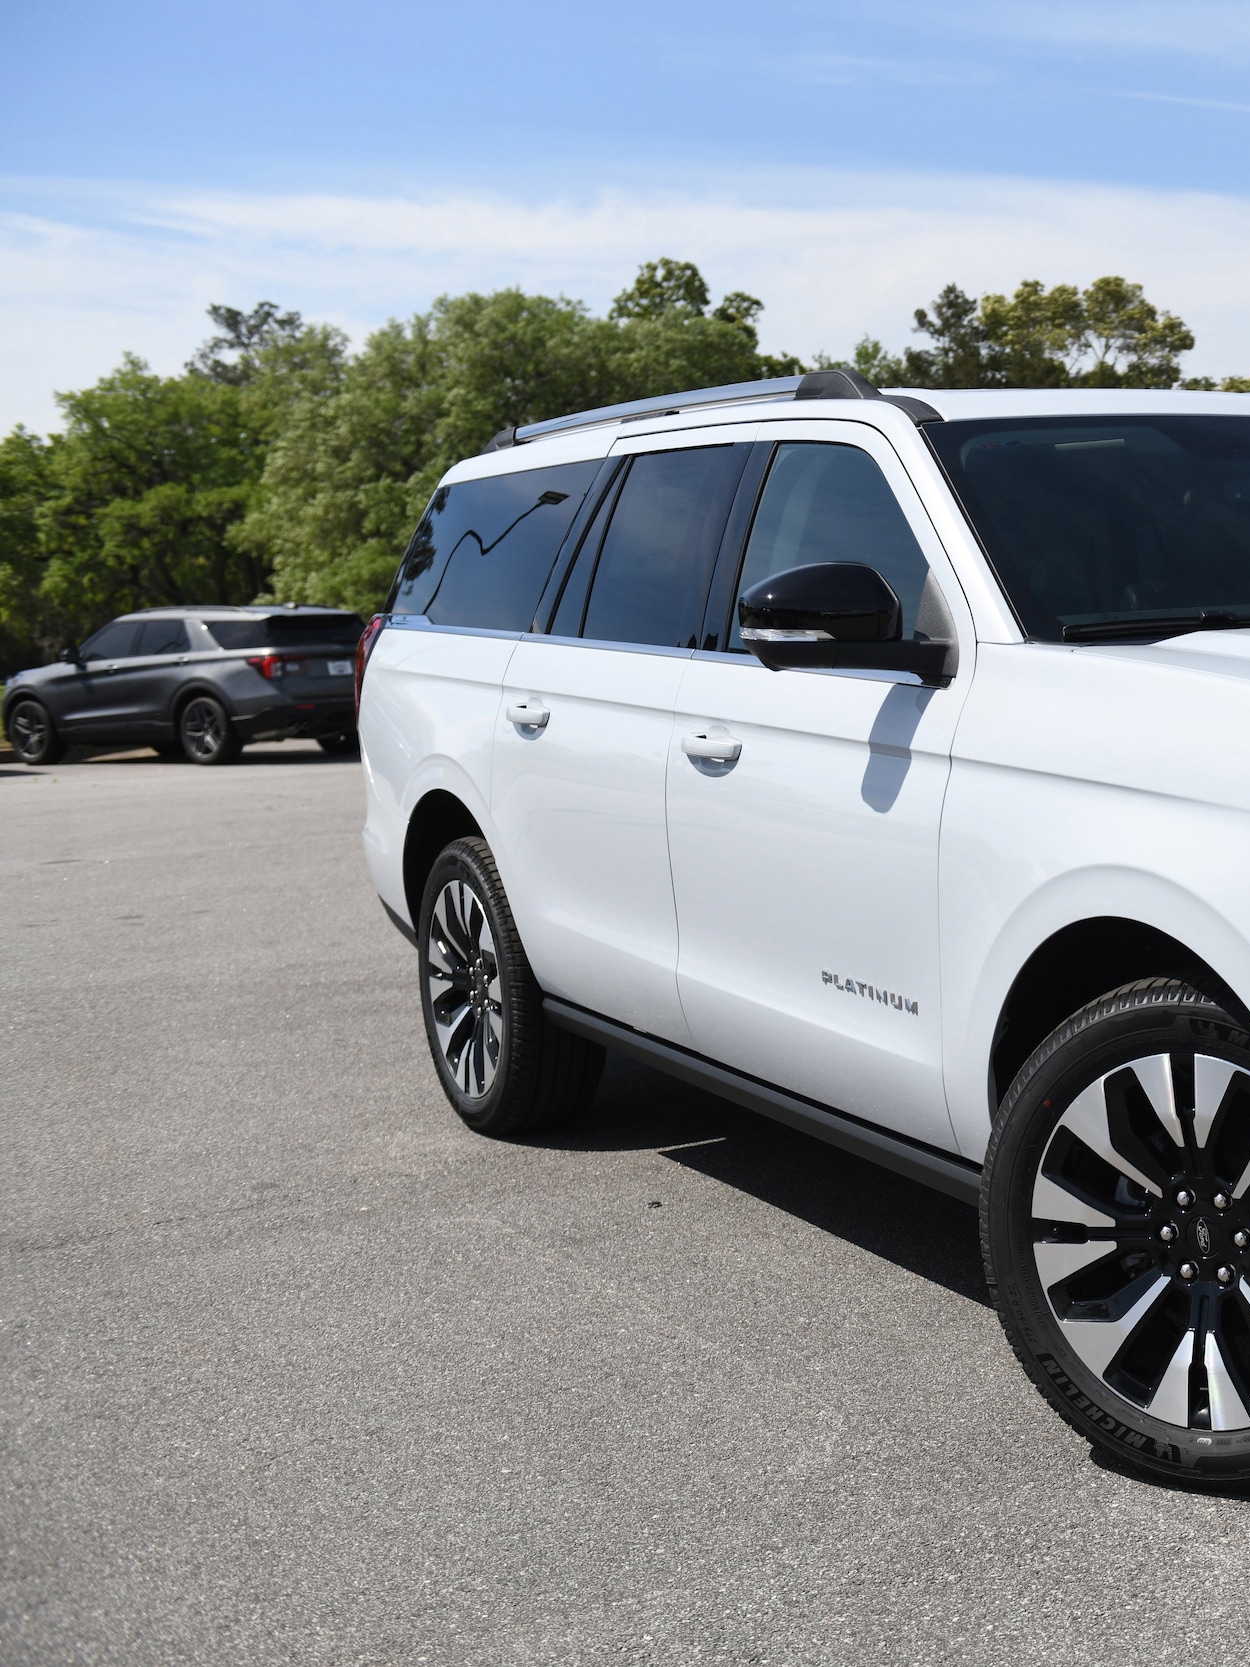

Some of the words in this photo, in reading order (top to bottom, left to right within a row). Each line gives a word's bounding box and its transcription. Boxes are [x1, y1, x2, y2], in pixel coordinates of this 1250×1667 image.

[821, 970, 919, 1016] PLATINUM
[1197, 1225, 1208, 1248] Ford
[1042, 1359, 1148, 1449] MICHELIN
